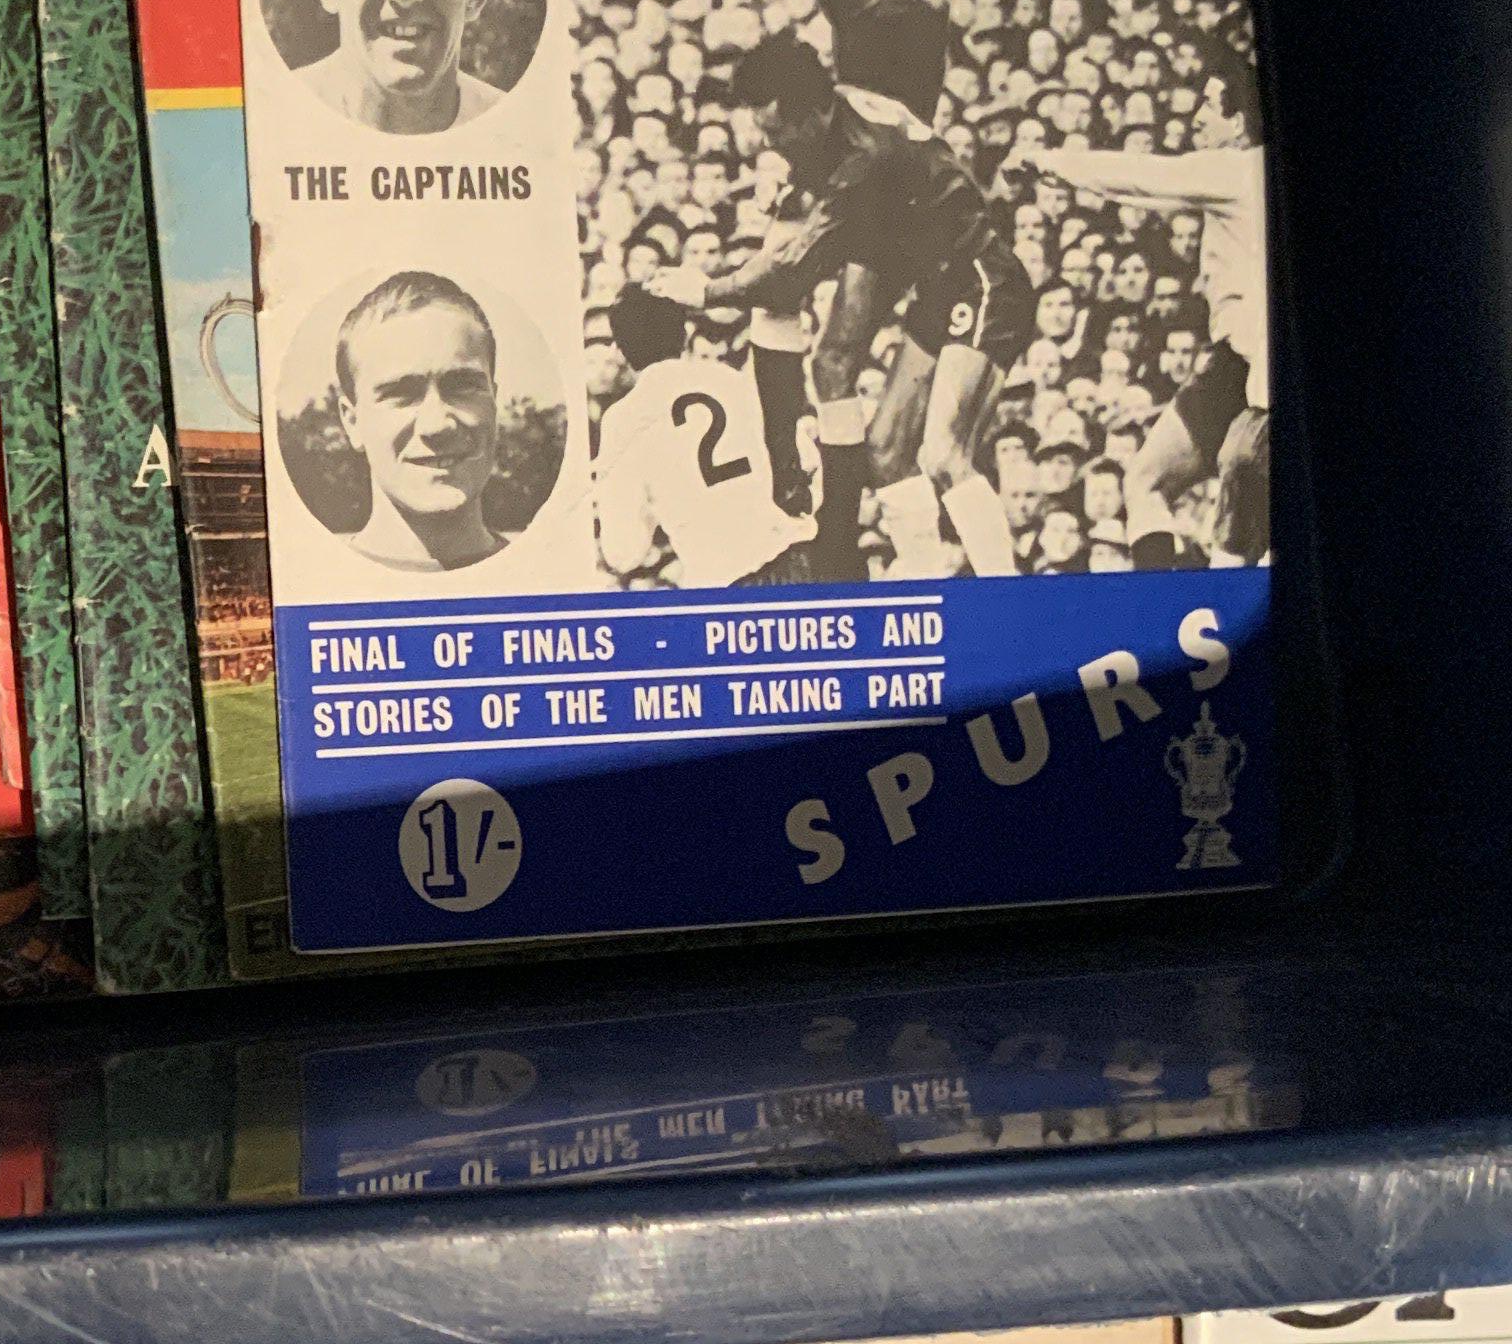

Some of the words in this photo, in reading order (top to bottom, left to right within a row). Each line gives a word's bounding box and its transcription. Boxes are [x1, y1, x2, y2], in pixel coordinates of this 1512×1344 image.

[284, 166, 349, 200] THE
[371, 165, 531, 200] CAPTAINS
[671, 390, 752, 488] 2
[309, 634, 406, 676] FINAL
[433, 632, 476, 669] OF
[502, 625, 616, 666] FINALS
[705, 612, 859, 657] PICTURES
[882, 612, 945, 651] AND
[312, 694, 454, 740] STORIES
[481, 691, 523, 730] OF
[544, 686, 608, 726] THE
[633, 683, 706, 723] MEN
[730, 676, 842, 718] TAKING
[867, 671, 947, 711] PART
[783, 607, 1234, 885] SPURS
